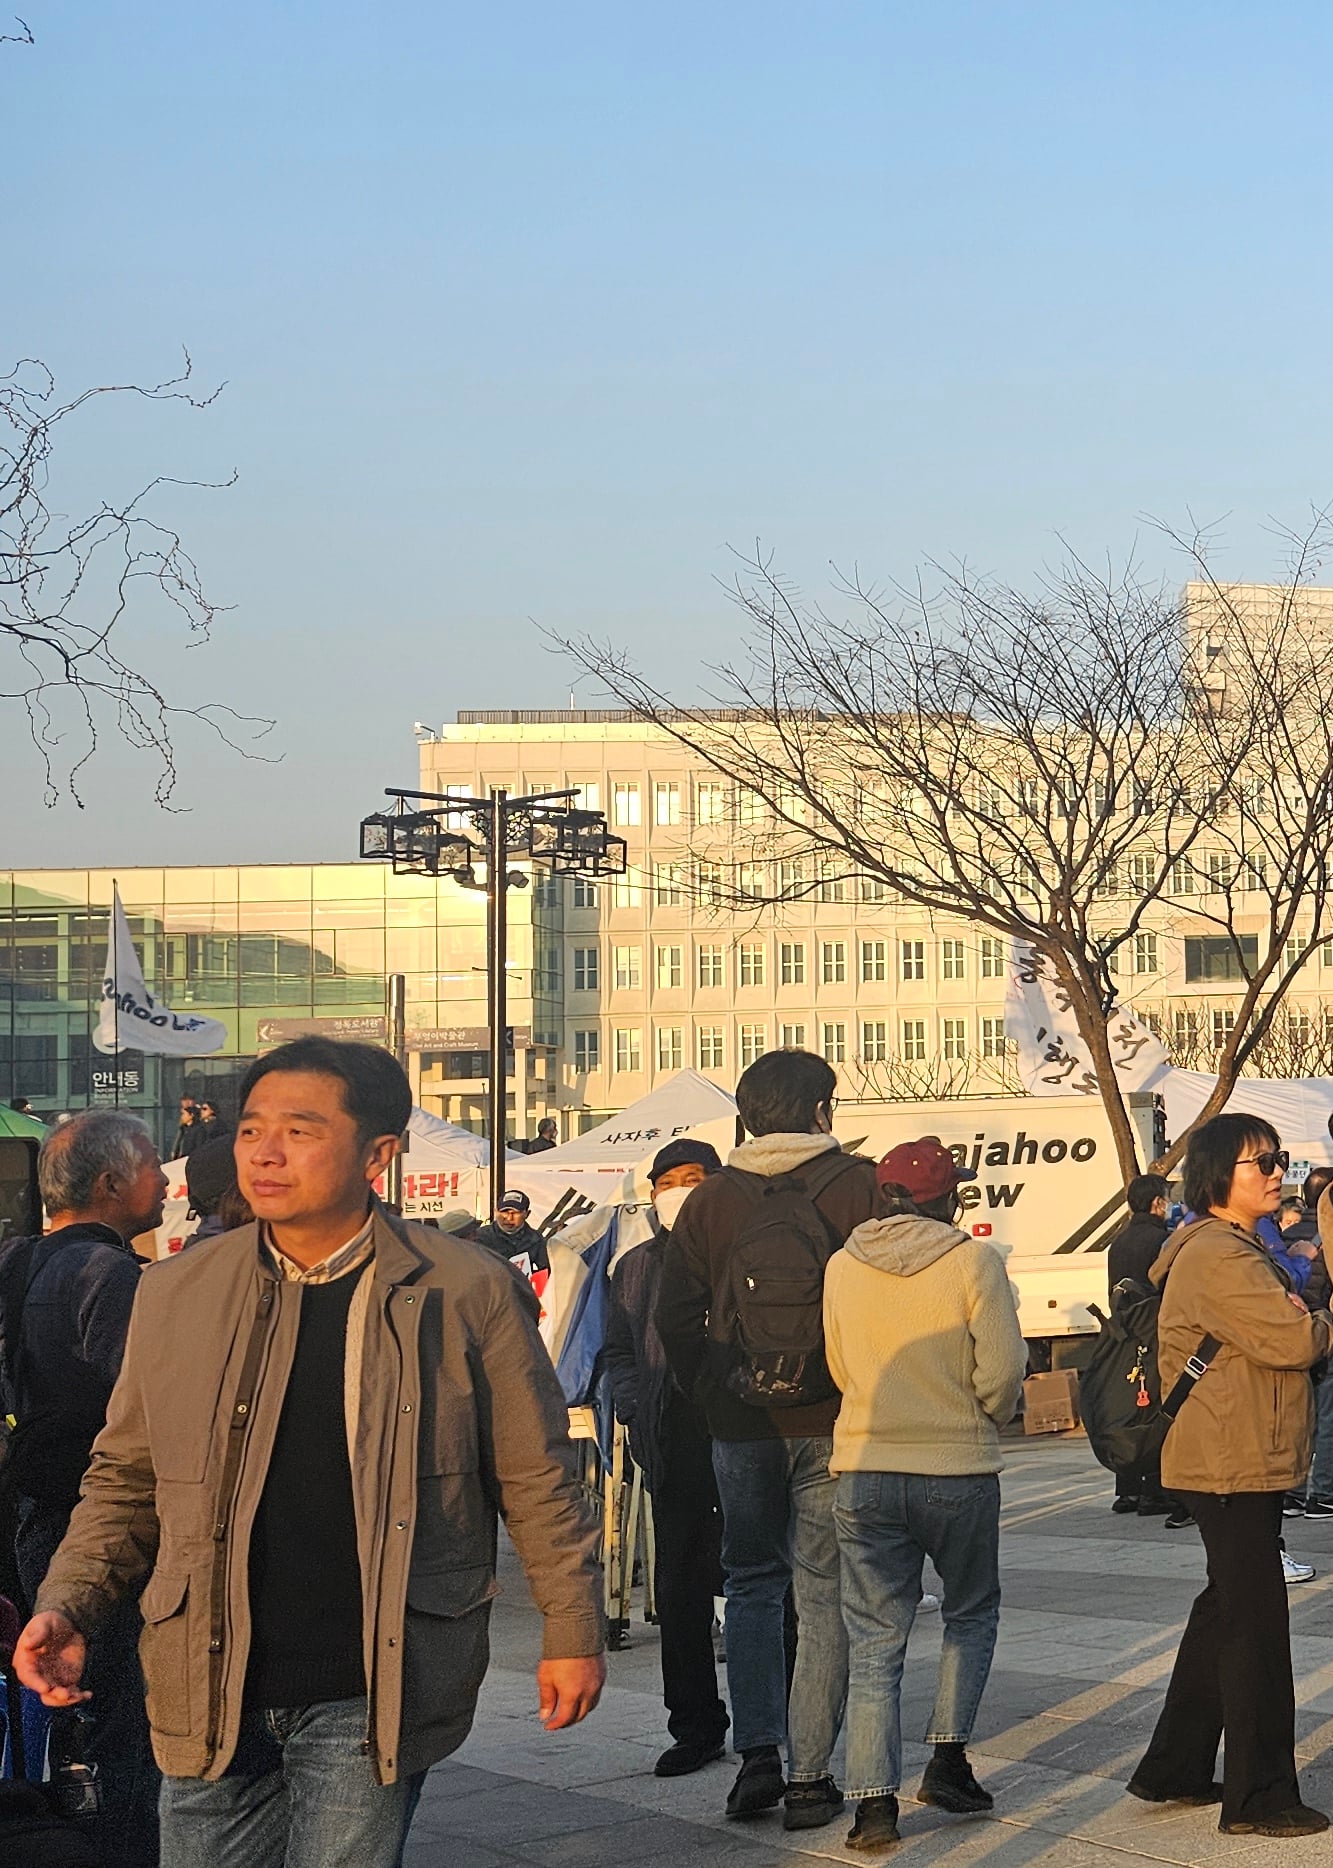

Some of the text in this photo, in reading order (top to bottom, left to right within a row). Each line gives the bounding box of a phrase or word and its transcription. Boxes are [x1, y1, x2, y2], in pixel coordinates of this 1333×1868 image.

[93, 1071, 140, 1087] 안내동
[600, 1127, 662, 1145] 사자후
[948, 1131, 1097, 1174] ajahoo
[958, 1182, 1025, 1211] ew
[420, 1200, 443, 1213] 시선
